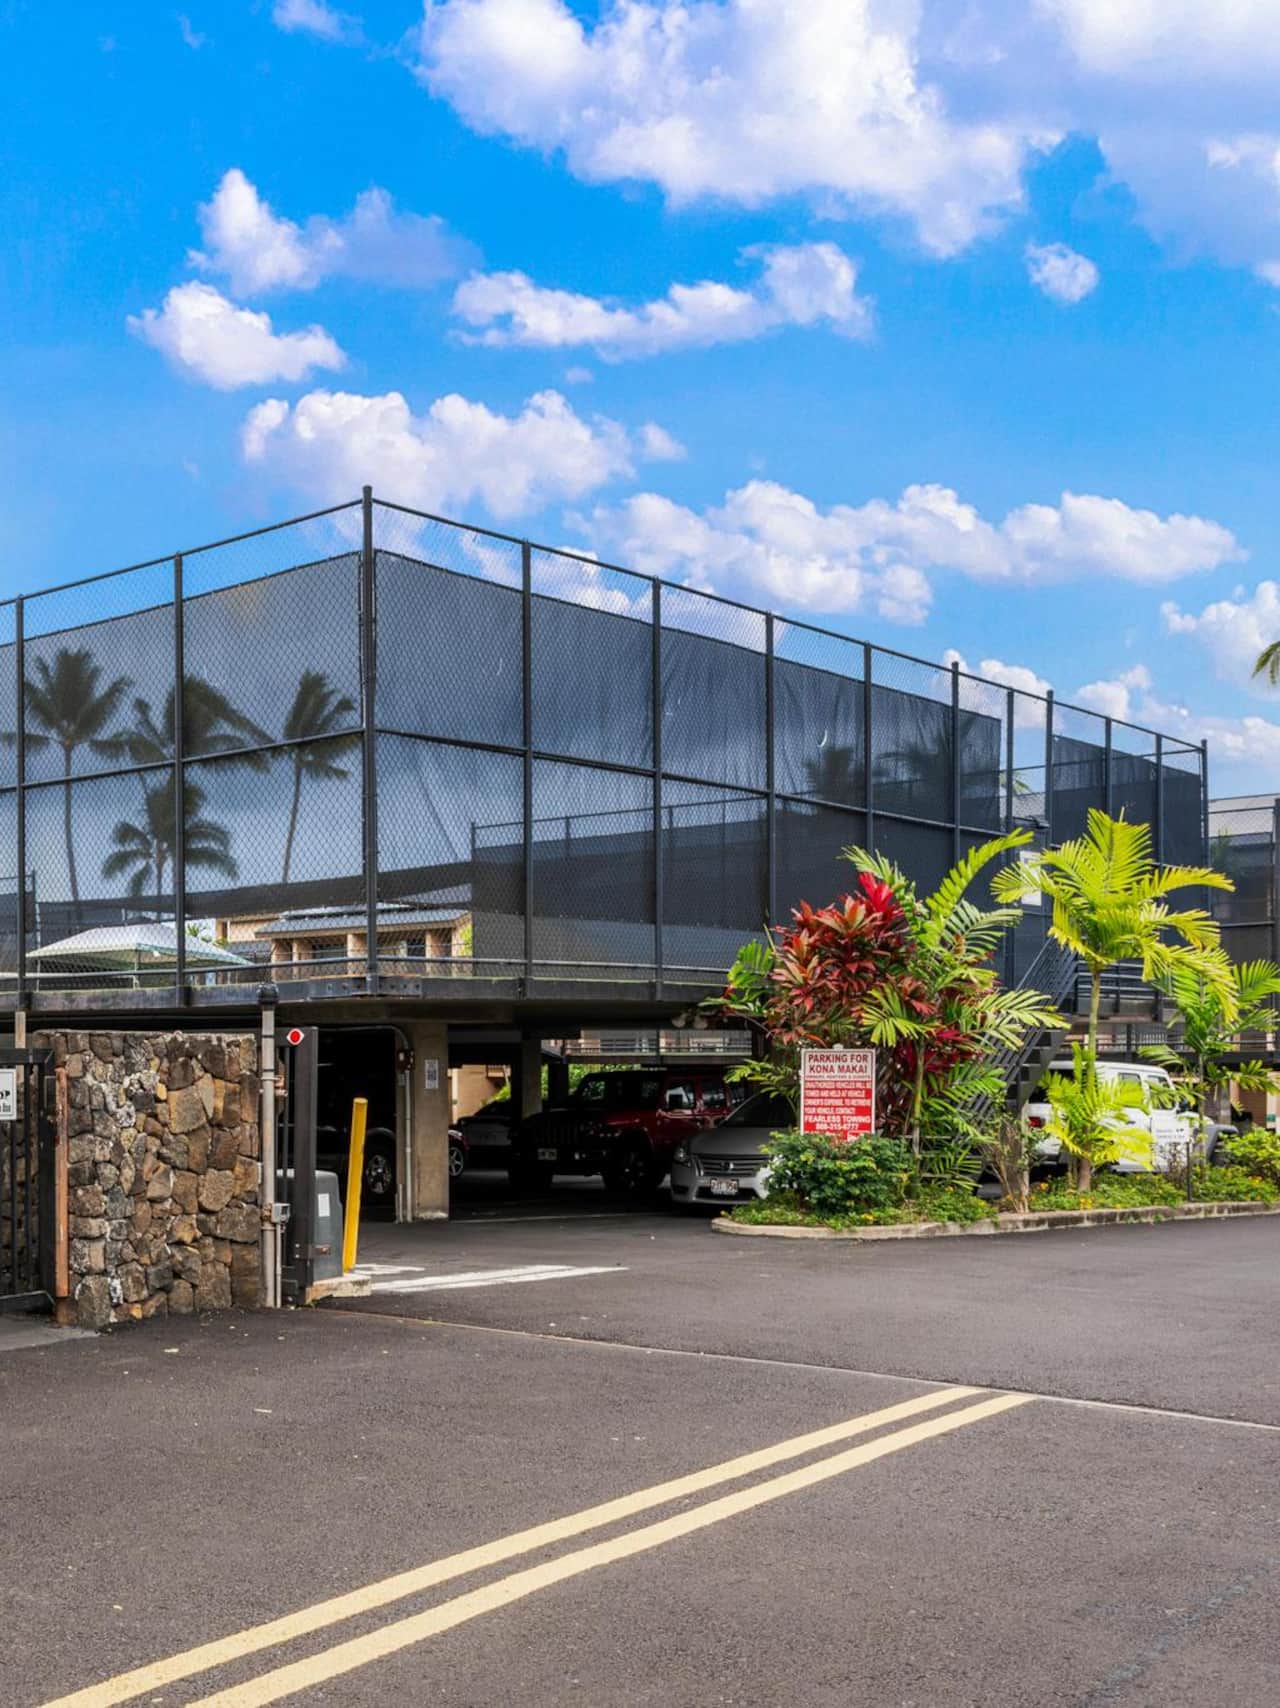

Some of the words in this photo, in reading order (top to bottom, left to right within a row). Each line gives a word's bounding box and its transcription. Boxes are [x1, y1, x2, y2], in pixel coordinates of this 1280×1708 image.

[808, 1054, 848, 1063] PARKING
[850, 1054, 869, 1063] FOR
[809, 1064, 836, 1074] KONA
[837, 1064, 868, 1074] MAKAI
[2, 1102, 12, 1113] Use
[805, 1115, 841, 1123] FEARLESS
[842, 1115, 871, 1123] TOWING
